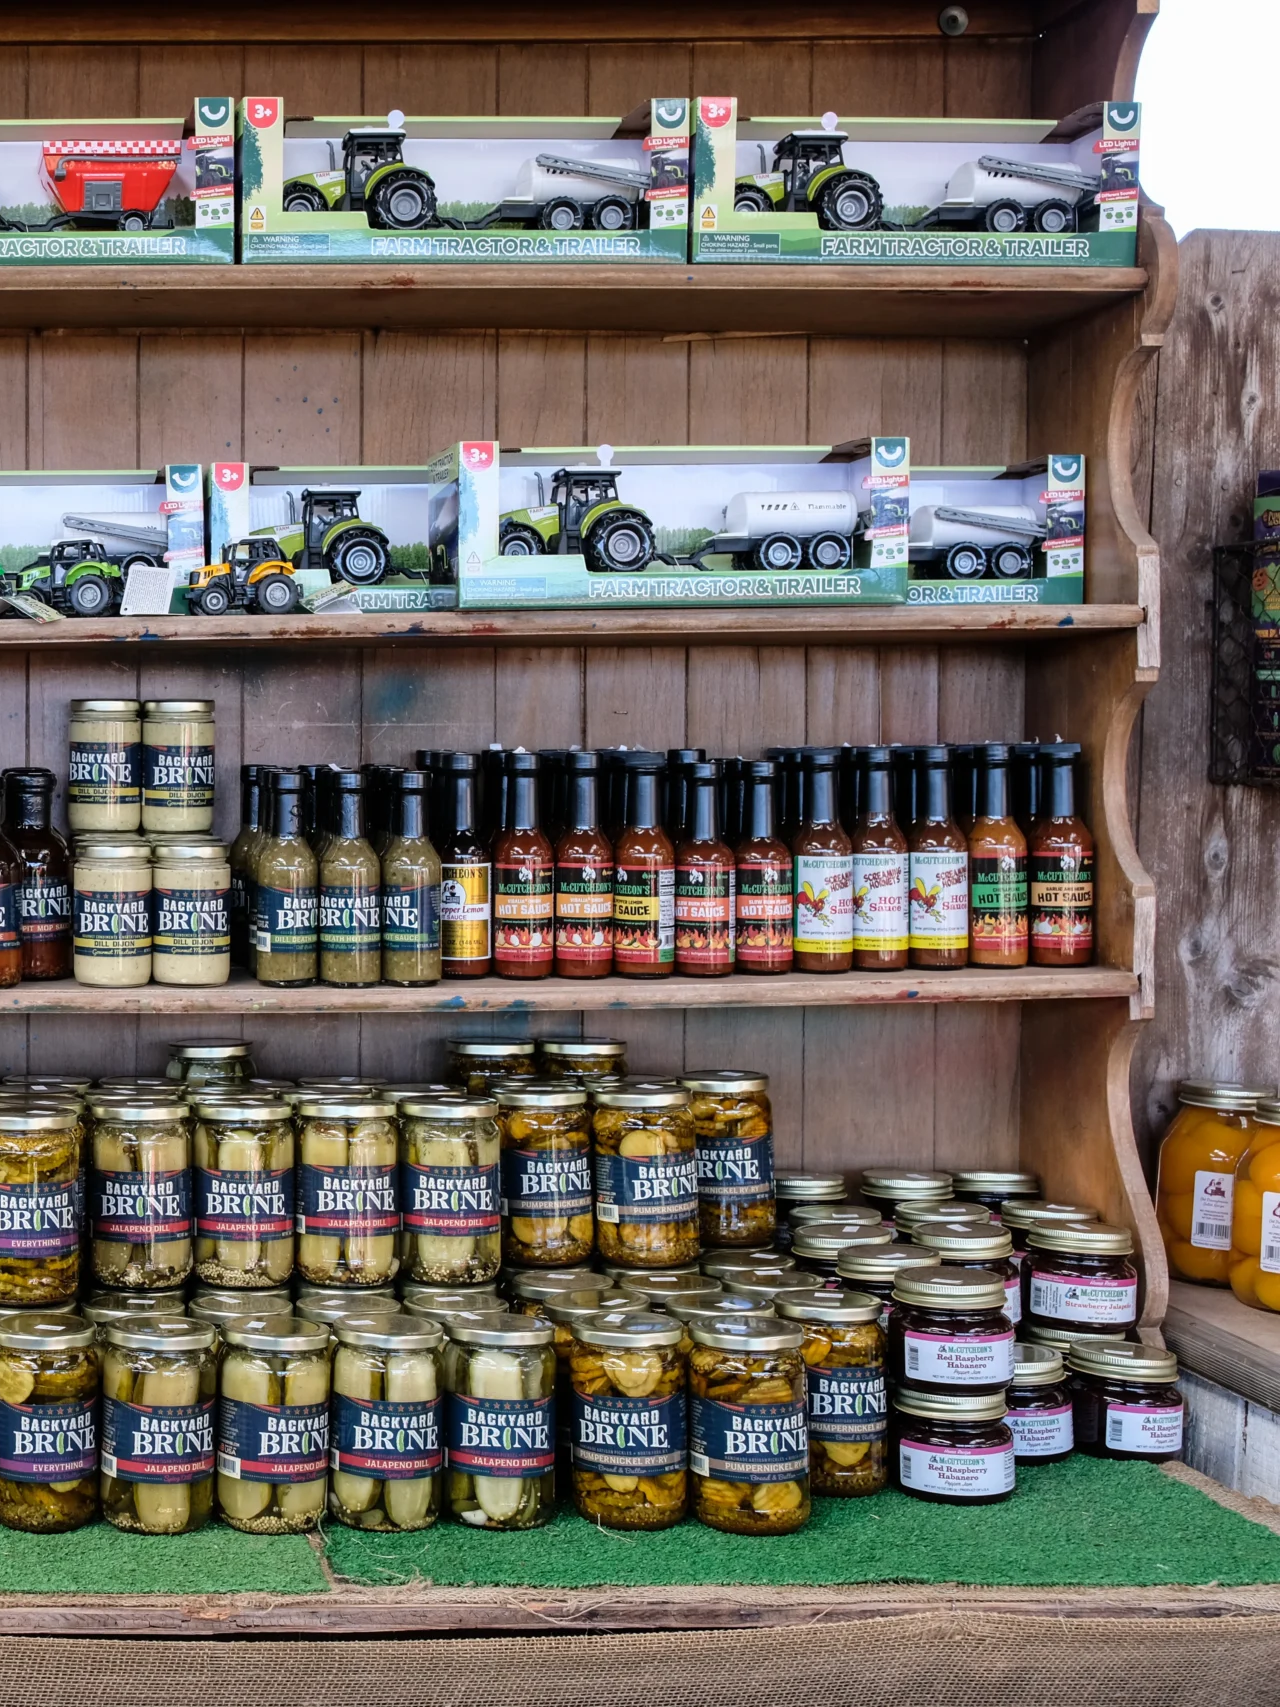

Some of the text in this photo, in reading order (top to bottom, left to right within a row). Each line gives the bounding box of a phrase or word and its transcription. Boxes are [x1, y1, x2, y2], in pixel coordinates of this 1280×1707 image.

[254, 105, 272, 119] 3+
[708, 104, 725, 118] 3+
[192, 137, 230, 146] LED Lights!
[648, 138, 686, 148] LED Lights!
[1099, 141, 1136, 150] LED Lights!
[80, 238, 97, 257] &
[100, 237, 185, 256] TRAILER
[372, 237, 640, 255] FARM TRACTOR & TRAILER
[822, 237, 1089, 257] FARM TRACTOR & TRAILER
[470, 448, 488, 462] 3+
[222, 469, 238, 482] 3+
[589, 576, 860, 597] FARM TRACTOR & TRAILER
[941, 585, 1037, 603] & TRAILER
[158, 754, 213, 767] BACKYARD
[153, 766, 214, 786] BRINE
[864, 867, 901, 882] SCREAMING
[1038, 871, 1091, 881] McCUTCHEON'S
[499, 883, 550, 893] McCUTCHEON'S
[871, 878, 900, 889] HORNETS
[321, 895, 375, 908] BACKYARD
[879, 897, 902, 905] HOT
[1038, 891, 1091, 902] HOT SAUCE
[84, 900, 144, 914] BACKYARD
[499, 903, 550, 915] HOT SAUCE
[870, 903, 901, 911] Sauce
[80, 913, 148, 934] BRINE
[94, 940, 110, 948] DILL
[527, 1157, 587, 1173] BACKYARD
[106, 1181, 173, 1195] BACKYARD
[521, 1171, 591, 1195] BRINE
[101, 1194, 180, 1217] BRINE
[522, 1200, 577, 1209] PUMPERNICKEL
[153, 1223, 170, 1232] DILL
[1065, 1301, 1107, 1310] Strawberry
[955, 1355, 994, 1363] Raspberry
[361, 1411, 433, 1427] BACKYARD
[585, 1405, 659, 1424] BACKYARD
[353, 1425, 437, 1453] BRINE
[579, 1419, 667, 1448] BRINE
[415, 1459, 428, 1467] DILL
[580, 1451, 667, 1465] PUMPERNICKEL RY-RY
